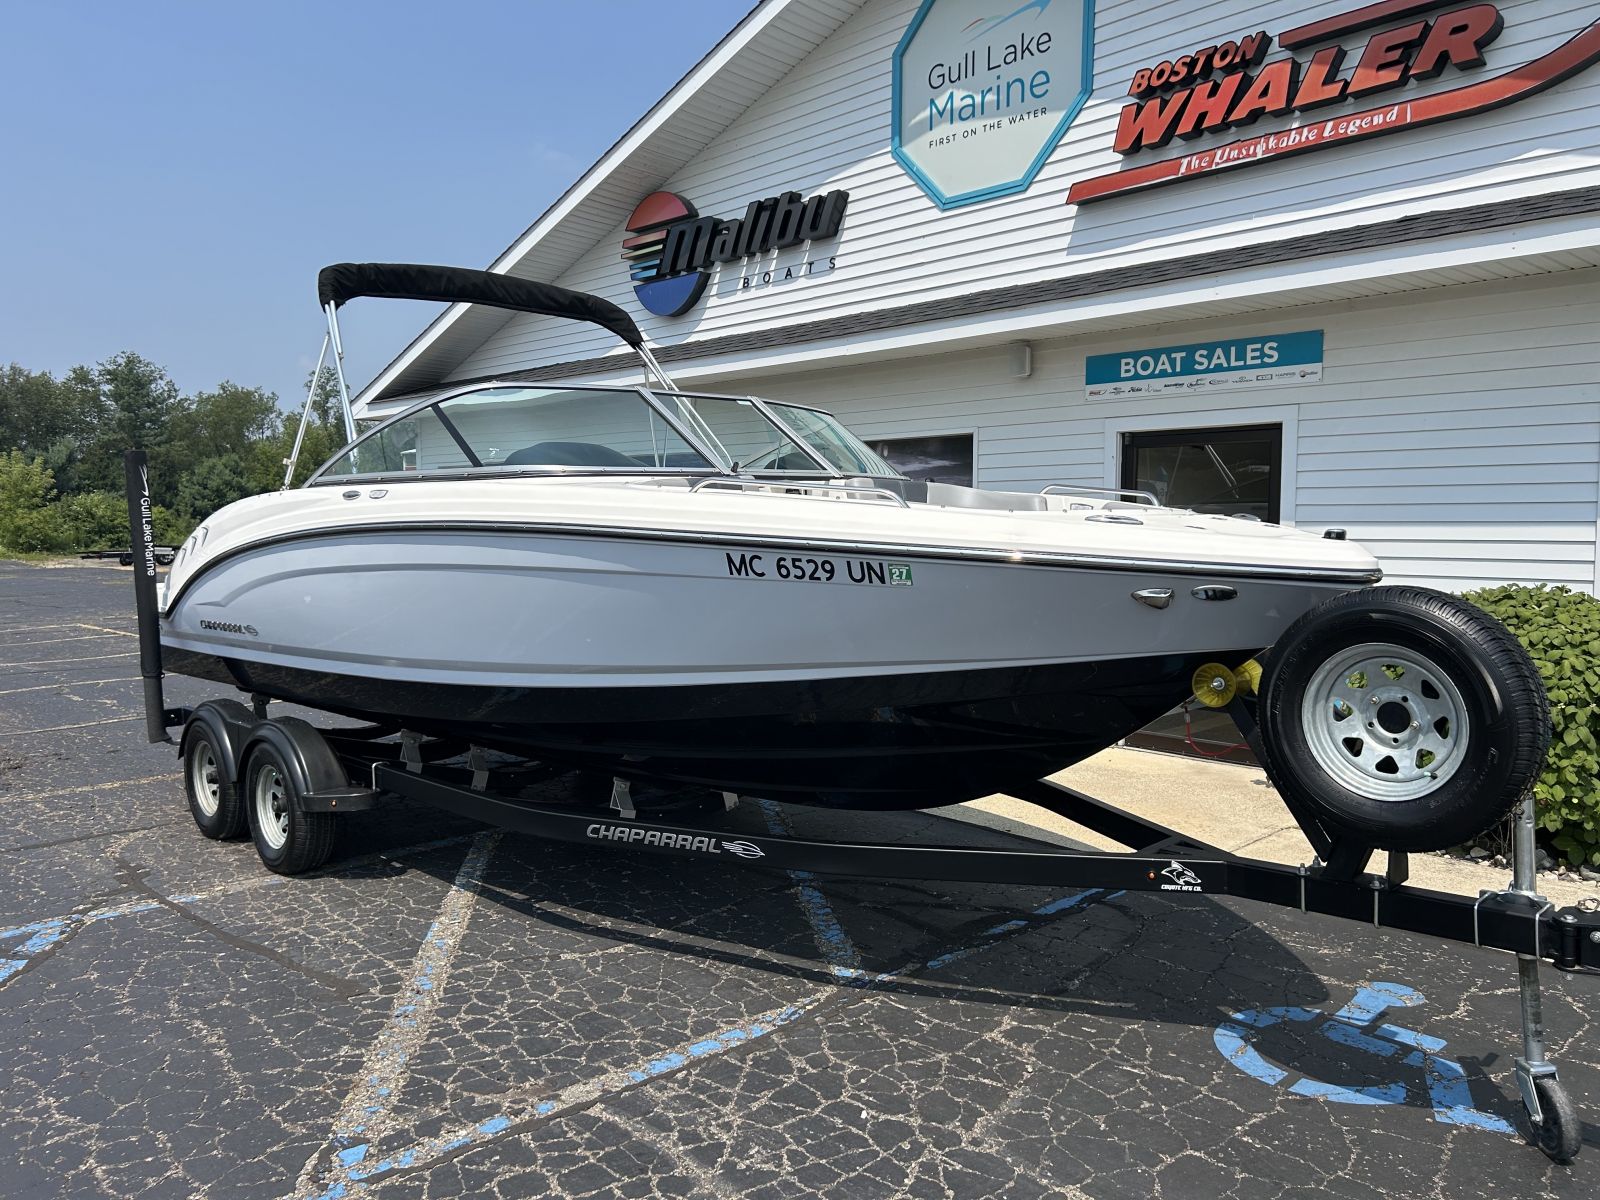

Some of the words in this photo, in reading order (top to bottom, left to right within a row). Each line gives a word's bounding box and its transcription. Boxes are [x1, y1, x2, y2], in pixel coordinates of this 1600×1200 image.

[928, 50, 976, 90] Gull
[987, 31, 1052, 71] Lake
[1128, 30, 1270, 98] BOSTON
[1113, 3, 1503, 154] WHALER
[928, 69, 1051, 131] Marine
[928, 133, 957, 149] FIRST
[962, 127, 977, 139] ON
[983, 120, 1003, 133] THE
[1008, 106, 1048, 125] WATER
[1178, 155, 1209, 176] The
[1322, 105, 1399, 136] Legend
[742, 257, 836, 289] BOATS
[1119, 351, 1187, 378] BOAT
[1193, 341, 1280, 370] SALES
[140, 497, 152, 517] Gull
[142, 518, 153, 541] Lake
[144, 542, 155, 576] Marine
[725, 552, 766, 577] MC
[776, 556, 836, 582] 6529
[846, 560, 886, 585] UN
[891, 568, 907, 580] 27
[586, 824, 722, 854] CHAPARRAL
